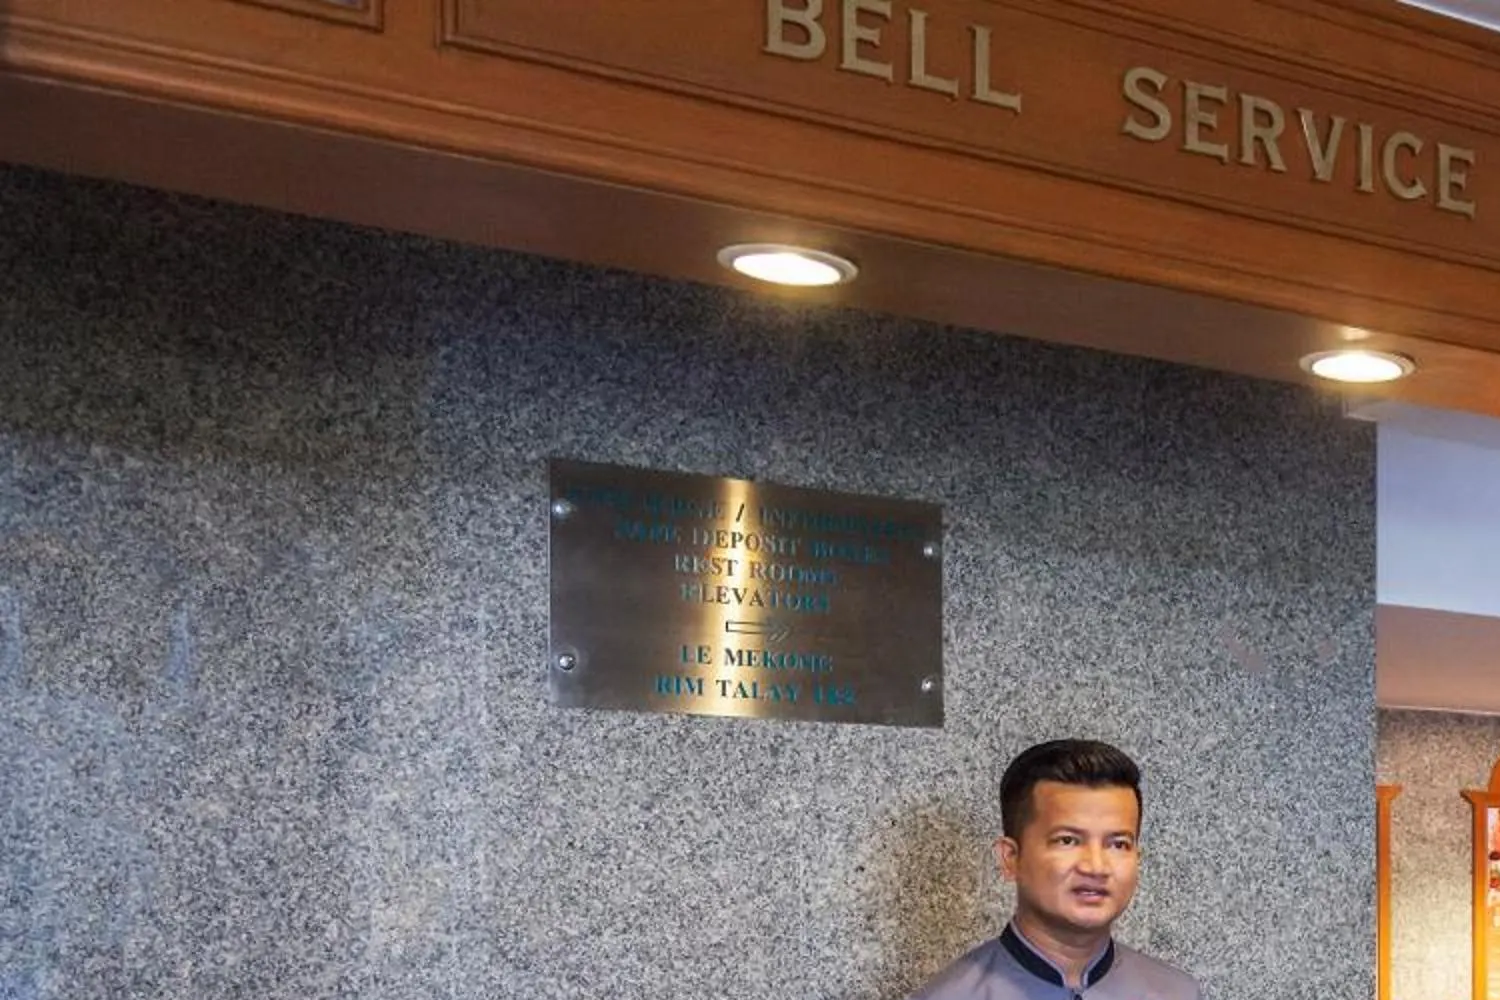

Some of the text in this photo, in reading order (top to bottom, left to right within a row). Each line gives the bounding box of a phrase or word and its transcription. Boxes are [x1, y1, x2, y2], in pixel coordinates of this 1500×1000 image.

[762, 0, 1476, 219] BELL SERVICE
[692, 526, 802, 556] DEPOSIT
[674, 553, 739, 578] REST
[681, 645, 833, 673] LE MEKONG
[655, 674, 704, 697] RIM
[716, 679, 800, 705] TALAY
